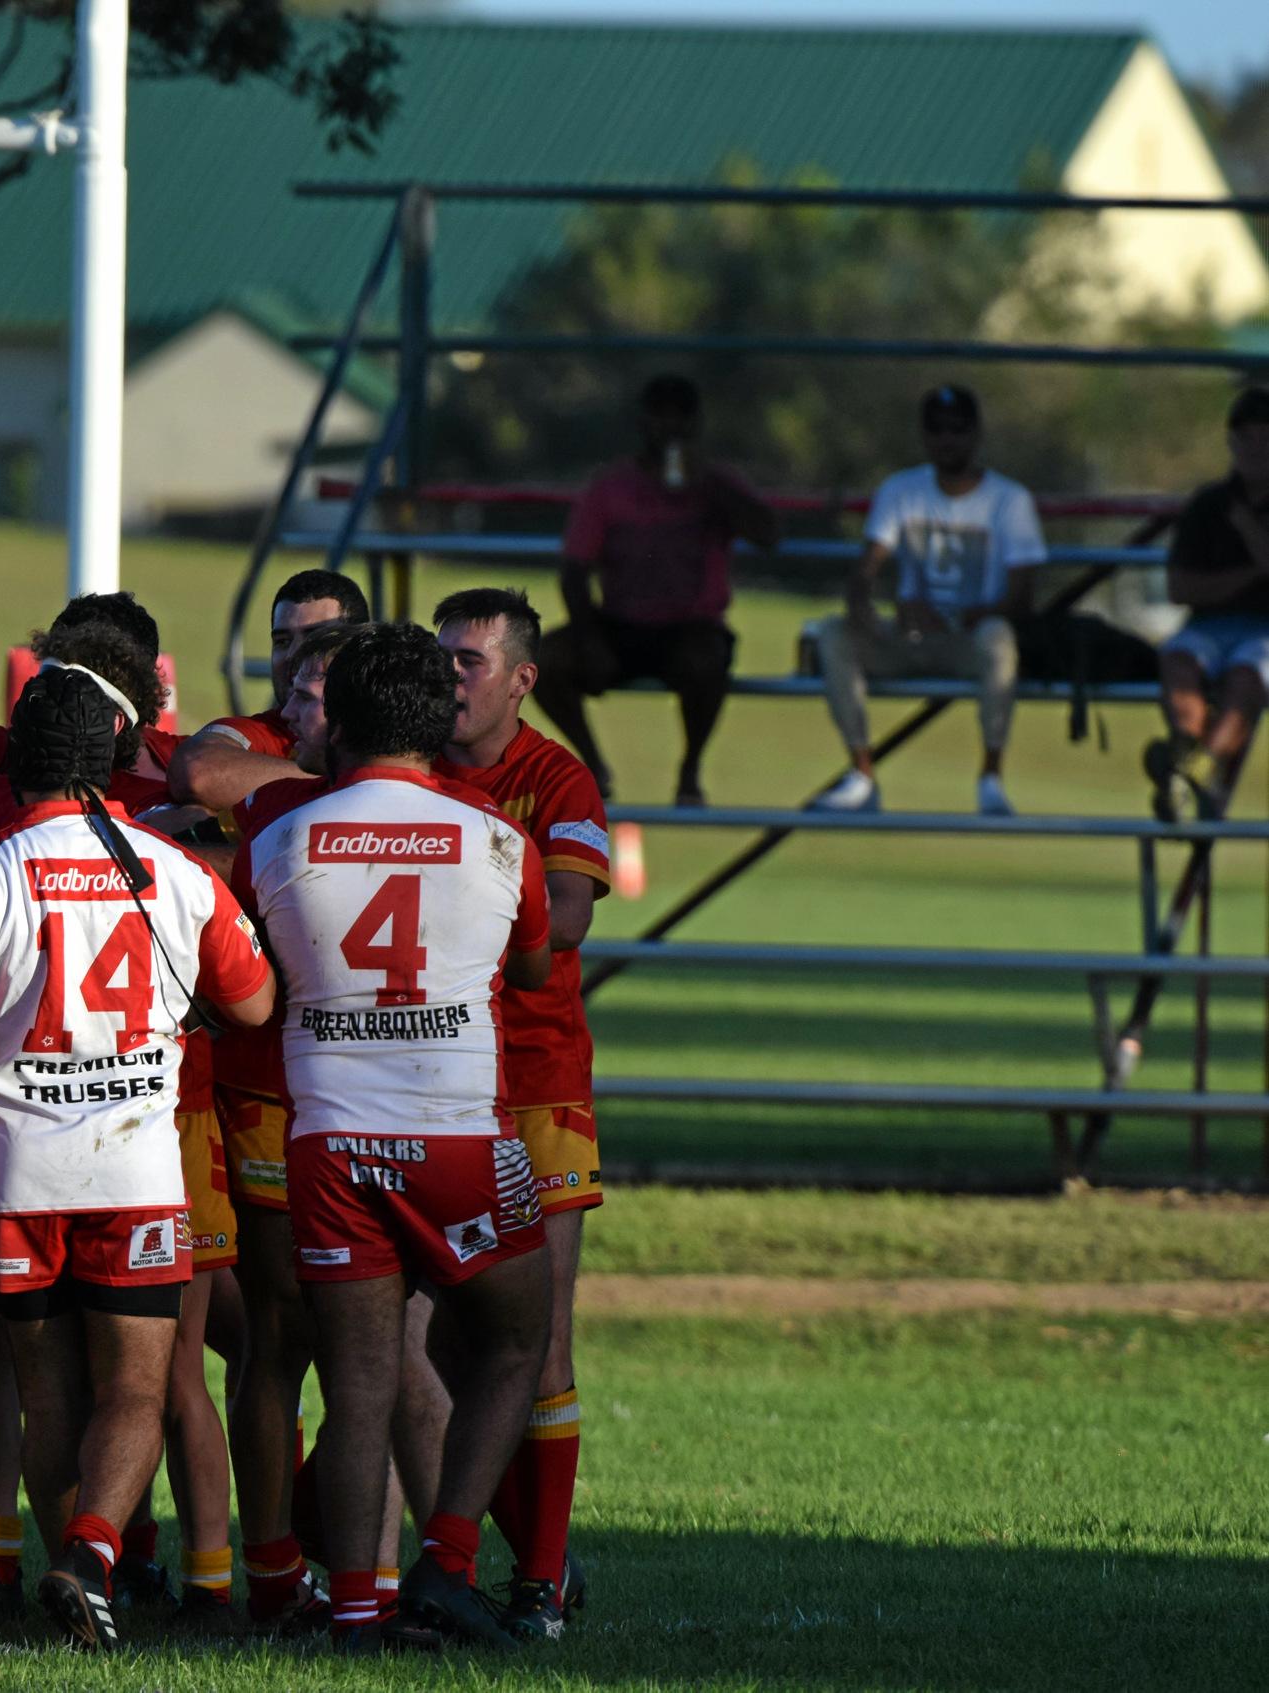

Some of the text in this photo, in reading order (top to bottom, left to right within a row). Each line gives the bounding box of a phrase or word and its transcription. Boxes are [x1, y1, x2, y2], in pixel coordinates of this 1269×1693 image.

[316, 830, 453, 855] Ladbrokes
[34, 867, 134, 892] Ladbrok
[340, 873, 428, 1007] 4
[22, 910, 155, 1054] 14
[300, 1003, 471, 1032] GREEN BROTHERS
[13, 1048, 164, 1075] PREMIUM
[19, 1076, 165, 1105] TRUSSES
[516, 1187, 531, 1203] CRL
[534, 1176, 563, 1190] AR
[192, 1235, 212, 1247] AR
[131, 1259, 153, 1267] MOTOR
